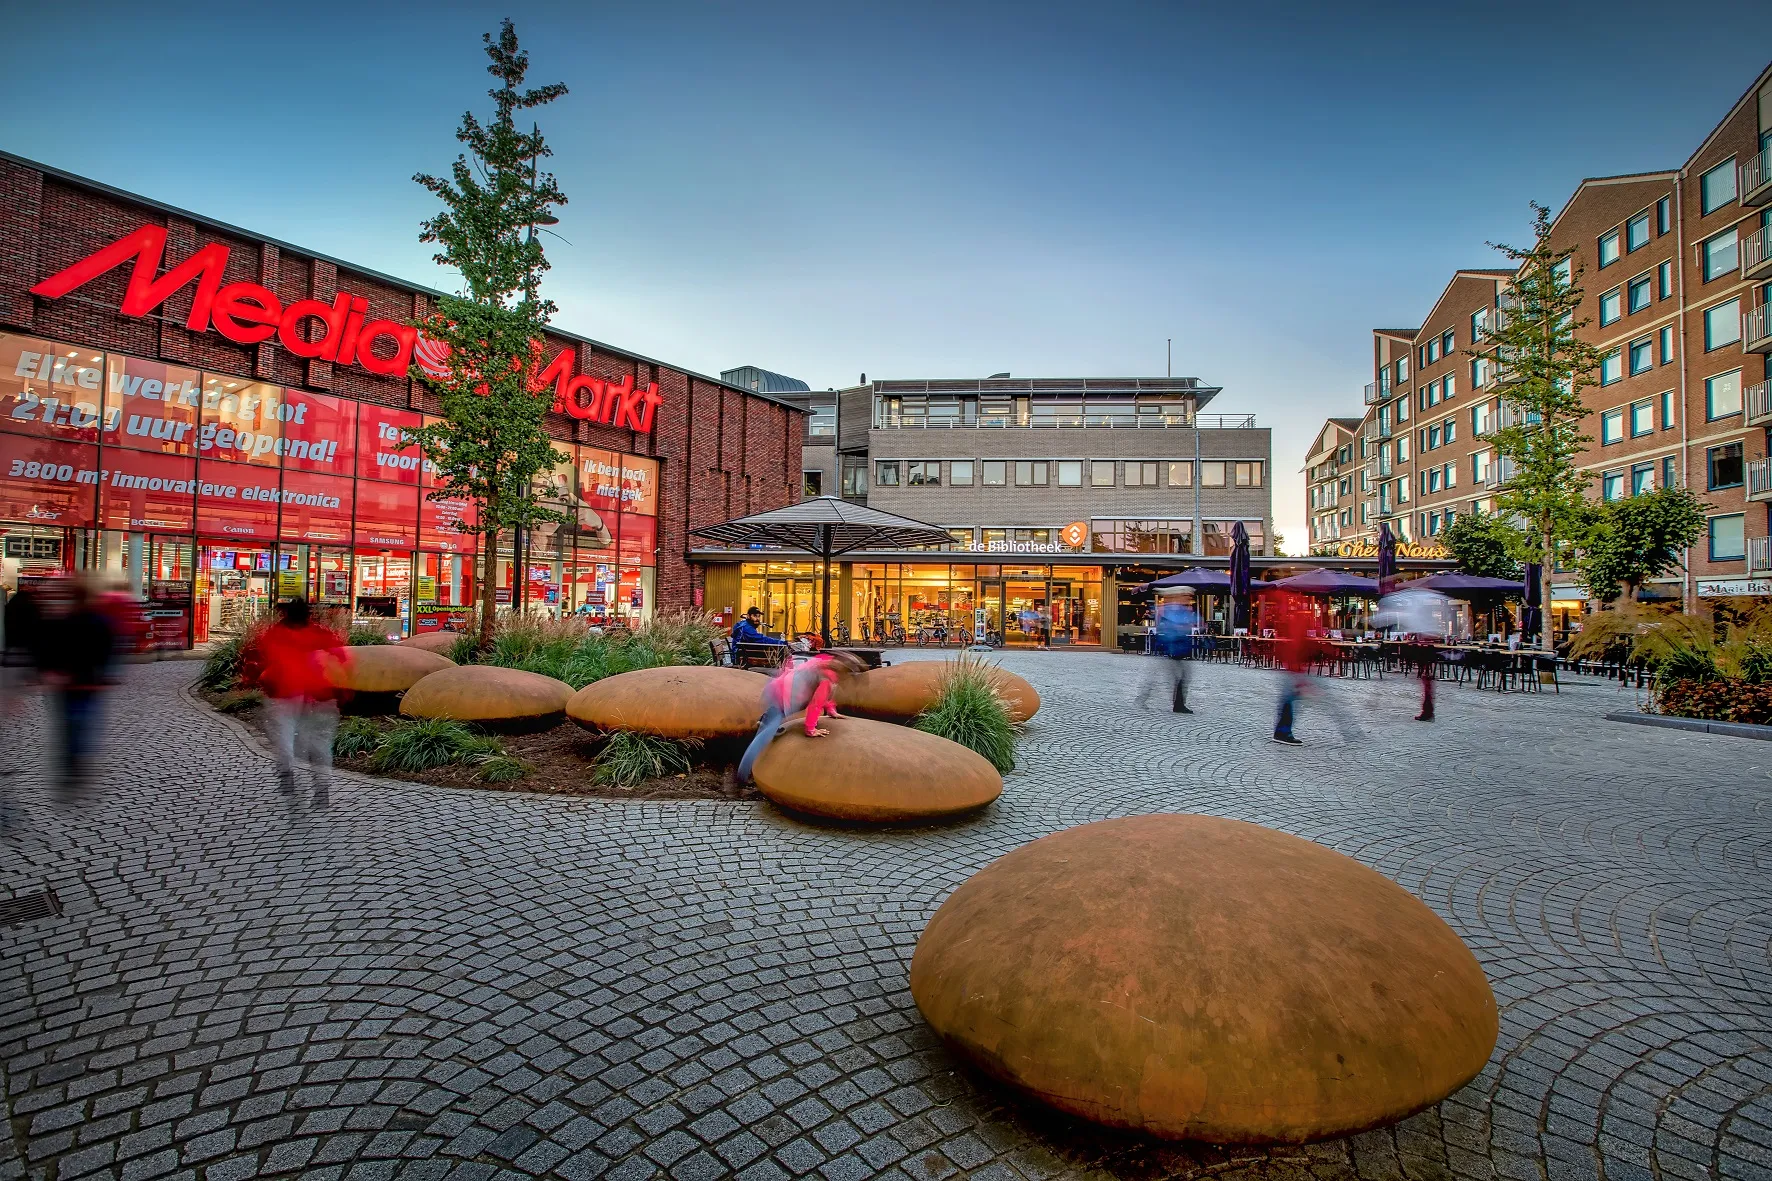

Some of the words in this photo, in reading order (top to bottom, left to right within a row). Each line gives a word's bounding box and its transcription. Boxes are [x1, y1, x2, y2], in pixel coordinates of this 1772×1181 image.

[29, 223, 417, 378] Media
[14, 350, 101, 389] Elke
[109, 370, 262, 421] werkdag
[264, 396, 308, 425] tot
[11, 392, 121, 432] 21:00
[126, 413, 194, 442] uur
[193, 422, 338, 463] geopend!
[378, 421, 398, 441] Te
[376, 452, 420, 471] voor
[584, 459, 597, 474] Ik
[598, 461, 621, 478] ben
[621, 466, 647, 482] toch
[9, 459, 73, 482] 3800
[111, 469, 237, 499] innovatieve
[241, 485, 341, 509] elektronica
[596, 483, 620, 499] niet
[25, 511, 63, 520] acer
[222, 525, 255, 534] Canon
[369, 536, 405, 546] SAMSUNG
[969, 540, 985, 553] de
[987, 540, 1062, 553] Bibliotheek
[1395, 540, 1451, 558] Nous
[416, 605, 433, 614] XXL
